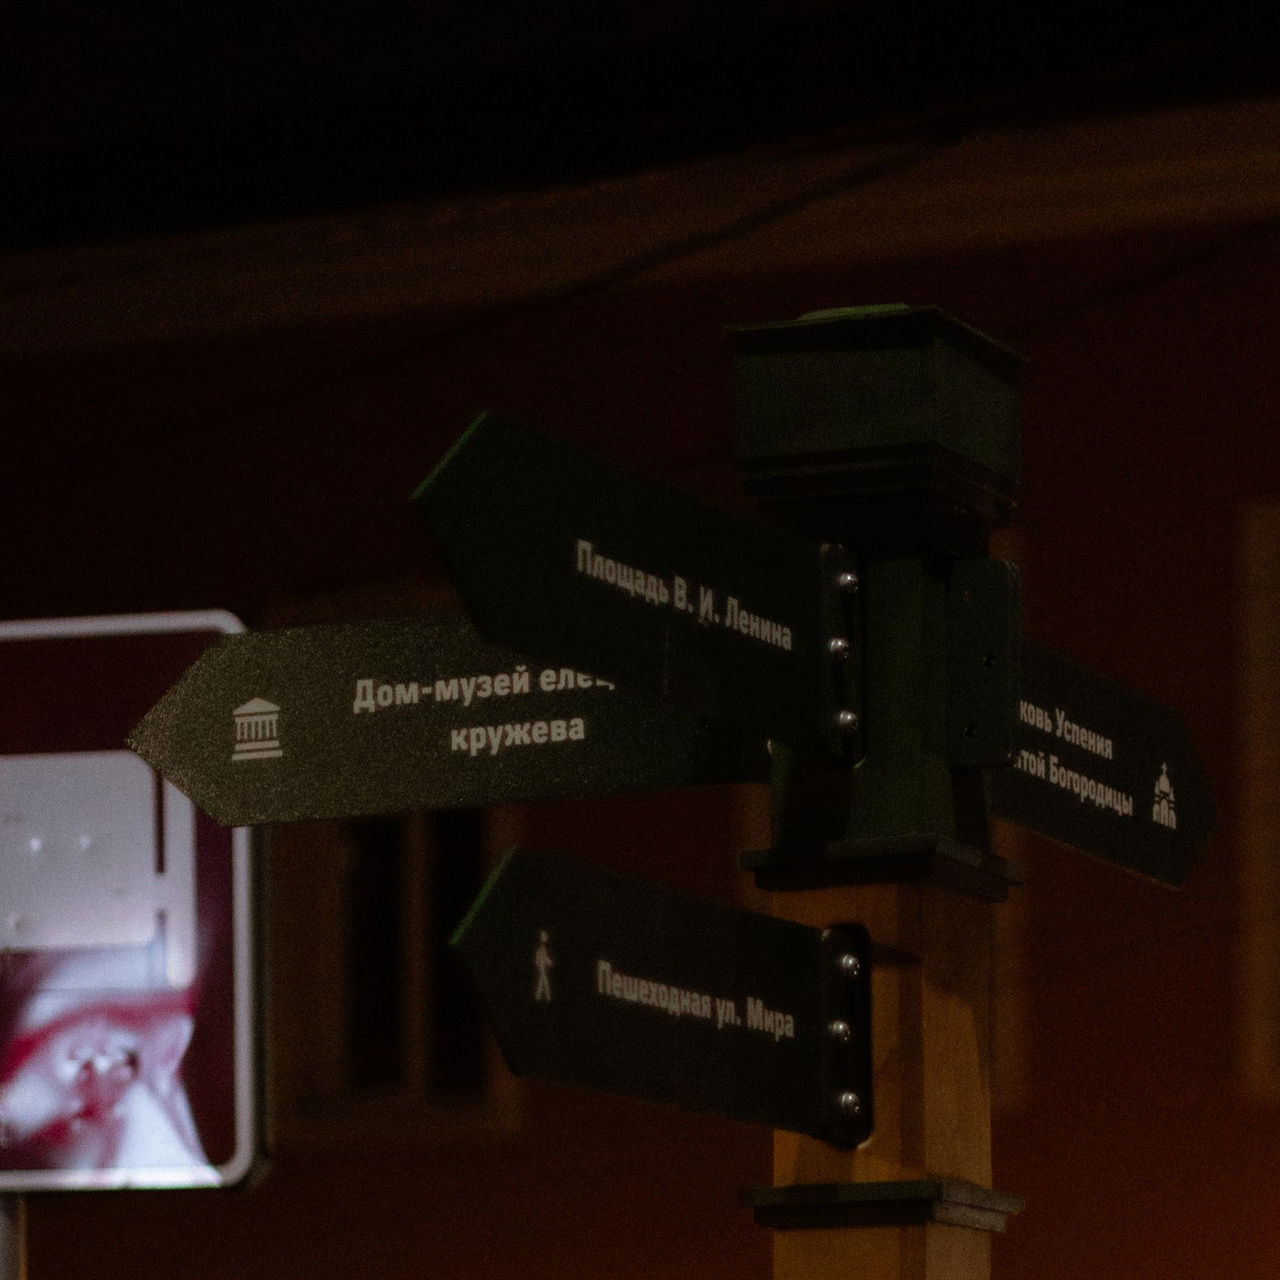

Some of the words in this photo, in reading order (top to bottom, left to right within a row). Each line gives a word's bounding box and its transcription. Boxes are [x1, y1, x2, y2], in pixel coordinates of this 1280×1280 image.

[576, 538, 669, 606] Площадь
[673, 574, 694, 615] В.
[699, 584, 720, 625] И.
[725, 596, 793, 651] Ленина
[353, 665, 530, 714] Дом-музей
[450, 717, 585, 757] кружева
[1055, 707, 1114, 761] Успения
[1049, 754, 1133, 817] Богородицы
[597, 959, 711, 1018] Пешеходная
[715, 997, 742, 1030] ул.
[747, 996, 796, 1043] Мира
